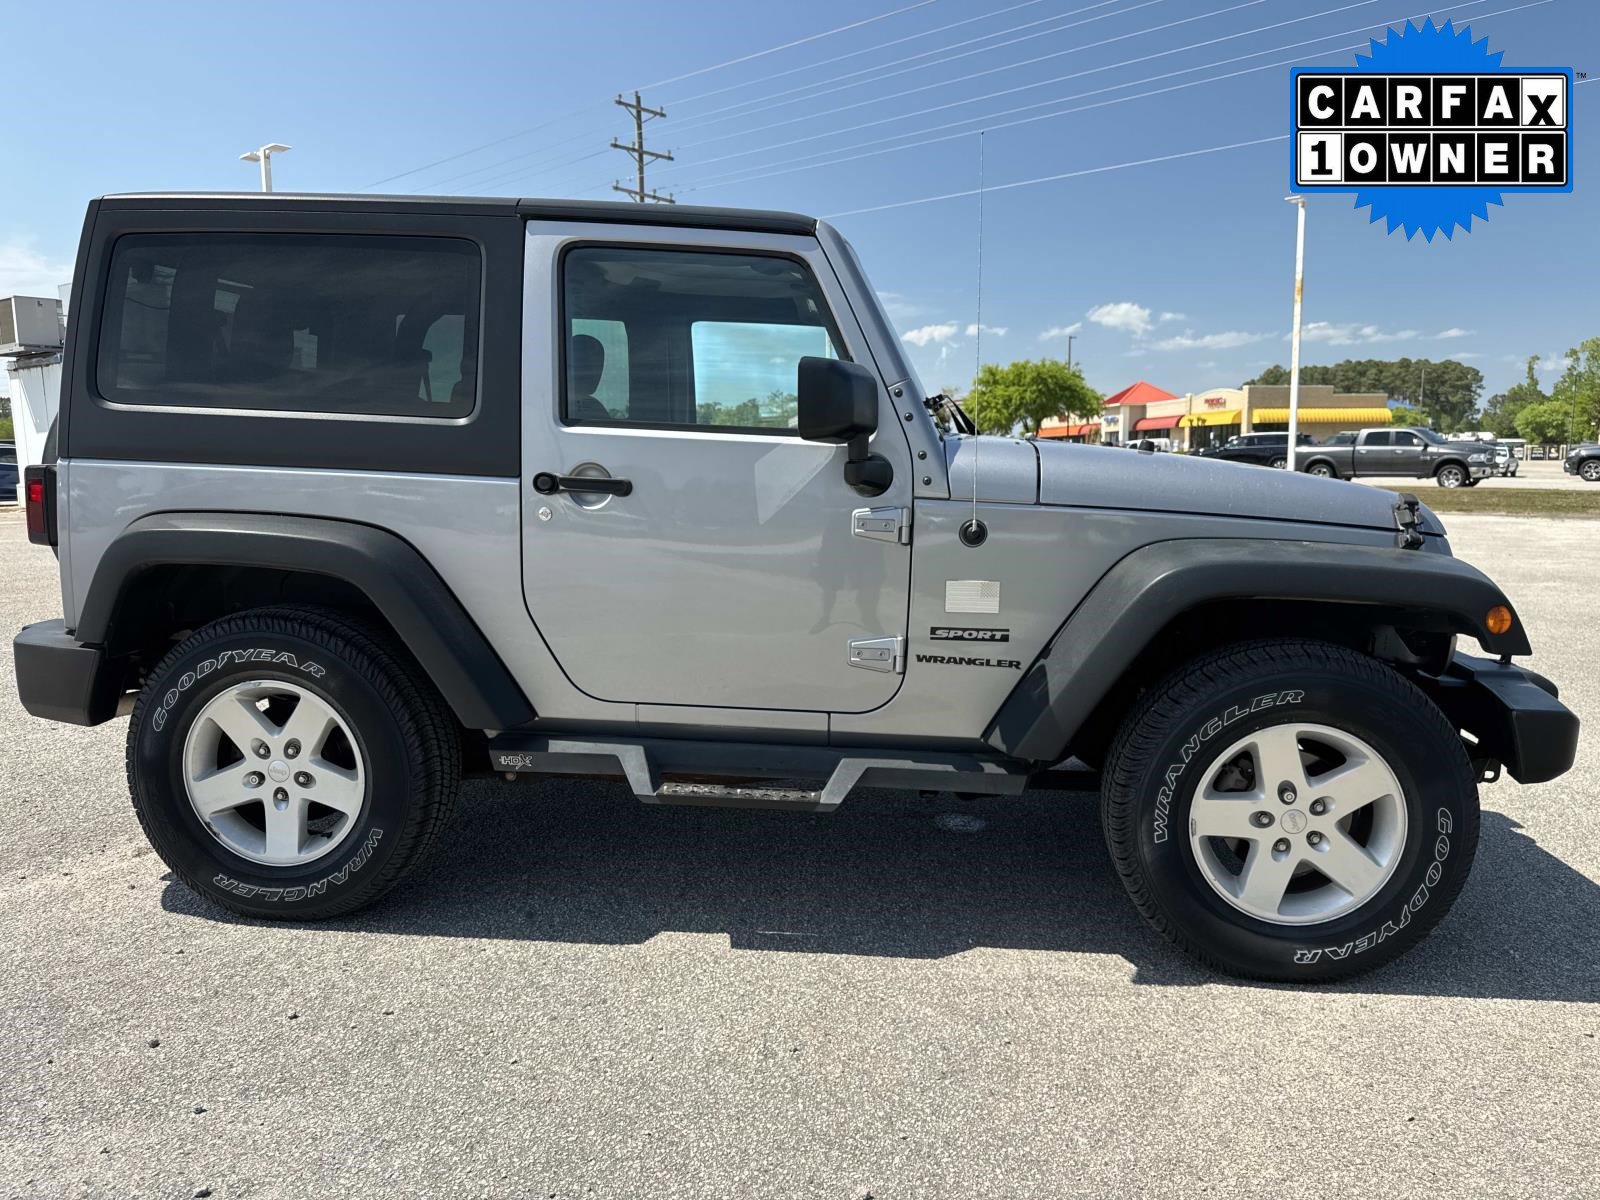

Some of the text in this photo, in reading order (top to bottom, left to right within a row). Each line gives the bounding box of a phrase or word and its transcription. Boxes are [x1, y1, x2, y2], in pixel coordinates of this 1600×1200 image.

[916, 654, 1022, 670] WRANGLER
[934, 629, 1006, 640] SPORT
[152, 648, 326, 732] GOODYEAR
[1154, 689, 1305, 844] WRANGLER
[212, 827, 384, 902] WRANGLER
[1293, 807, 1453, 964] GOODYEAR
